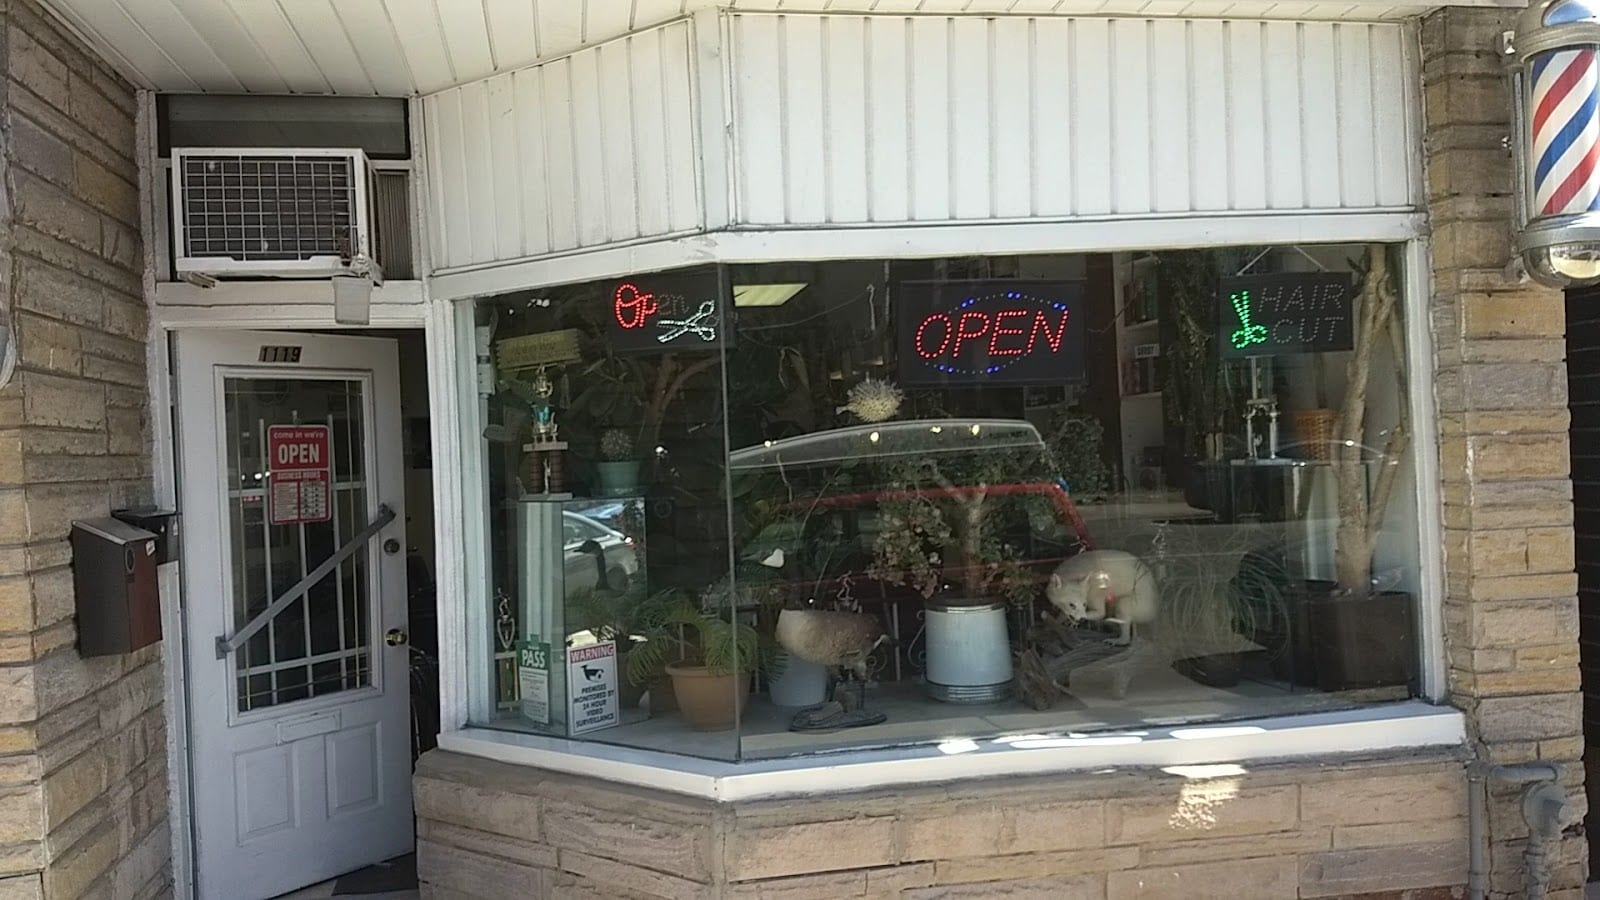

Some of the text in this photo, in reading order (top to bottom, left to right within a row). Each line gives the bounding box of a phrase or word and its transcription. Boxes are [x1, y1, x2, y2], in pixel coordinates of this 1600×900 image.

[1258, 283, 1345, 312] HAIR
[915, 309, 1069, 359] OPEN
[1272, 316, 1344, 344] CUT
[259, 346, 302, 362] 1119
[278, 443, 320, 464] OPEN
[522, 649, 546, 668] PASS
[571, 644, 614, 662] WARNING
[573, 690, 615, 704] MONITORED BY
[590, 699, 606, 708] HOUR
[586, 708, 604, 717] VIDEO
